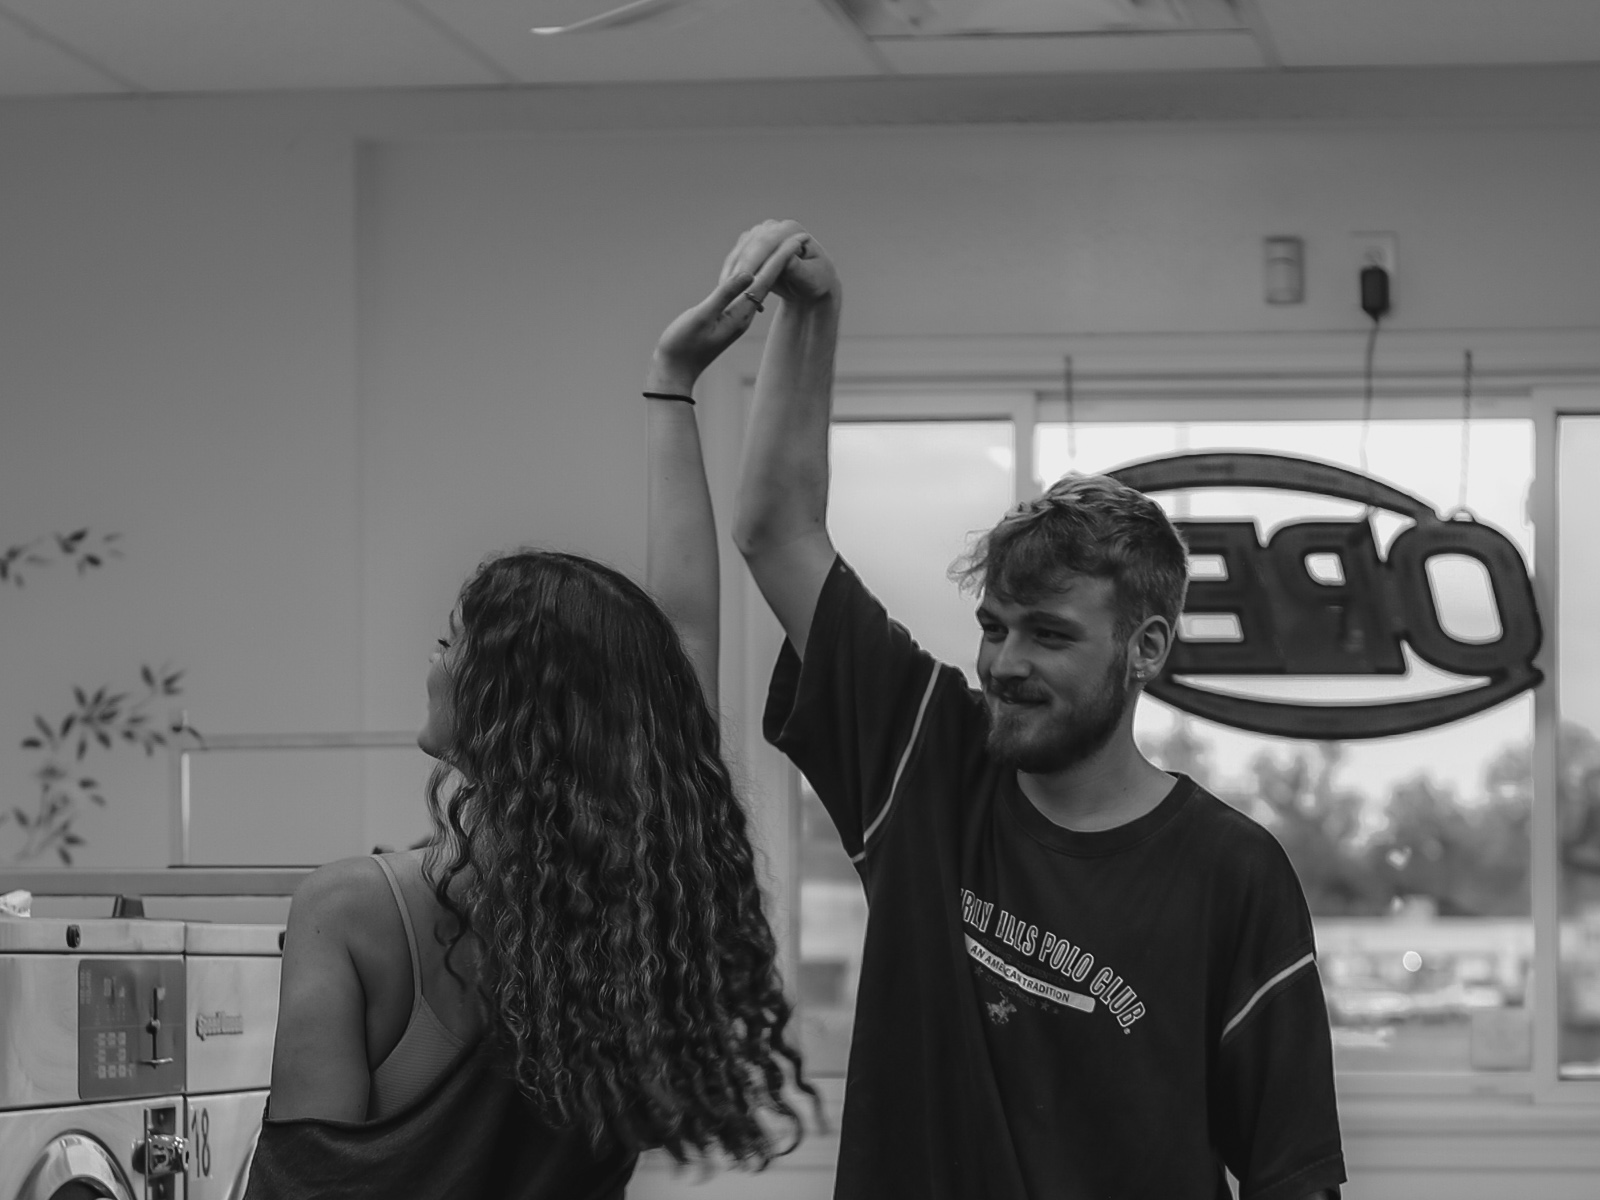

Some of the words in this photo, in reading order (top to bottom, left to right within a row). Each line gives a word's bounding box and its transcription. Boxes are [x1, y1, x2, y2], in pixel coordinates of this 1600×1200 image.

[961, 888, 994, 933] RLY
[995, 910, 1039, 957] ILLS
[1038, 931, 1095, 983] POLO
[1090, 966, 1146, 1028] CLUB
[970, 945, 986, 959] AN
[985, 955, 1022, 982] AMECAN
[1022, 977, 1071, 1003] TRADITION
[191, 1107, 211, 1179] 18
